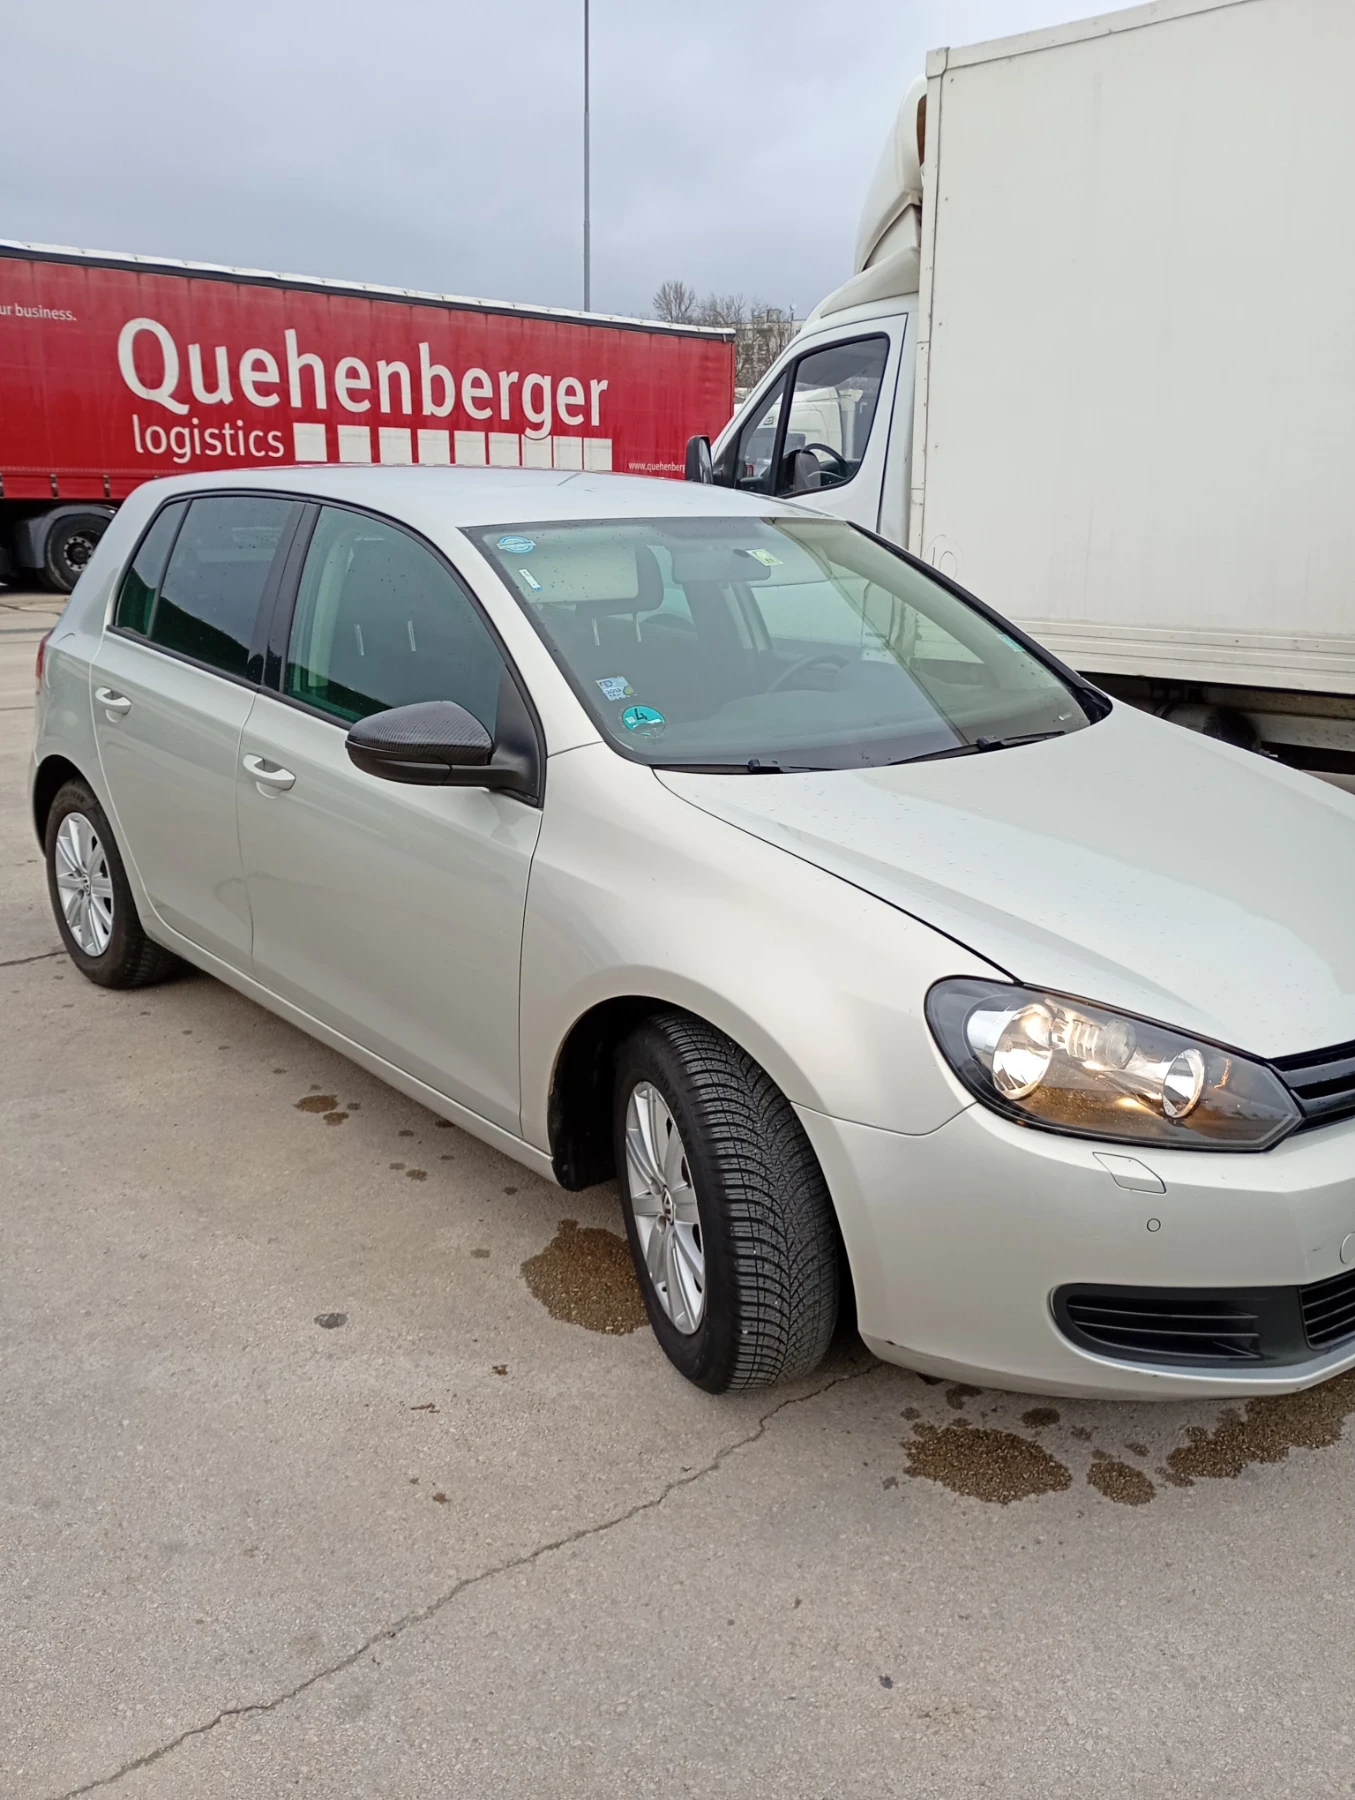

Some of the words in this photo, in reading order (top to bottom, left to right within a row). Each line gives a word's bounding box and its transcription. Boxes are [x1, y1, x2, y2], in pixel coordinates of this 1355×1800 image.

[14, 302, 77, 321] business.
[117, 317, 609, 441] Quehenberger
[132, 413, 285, 464] logistics
